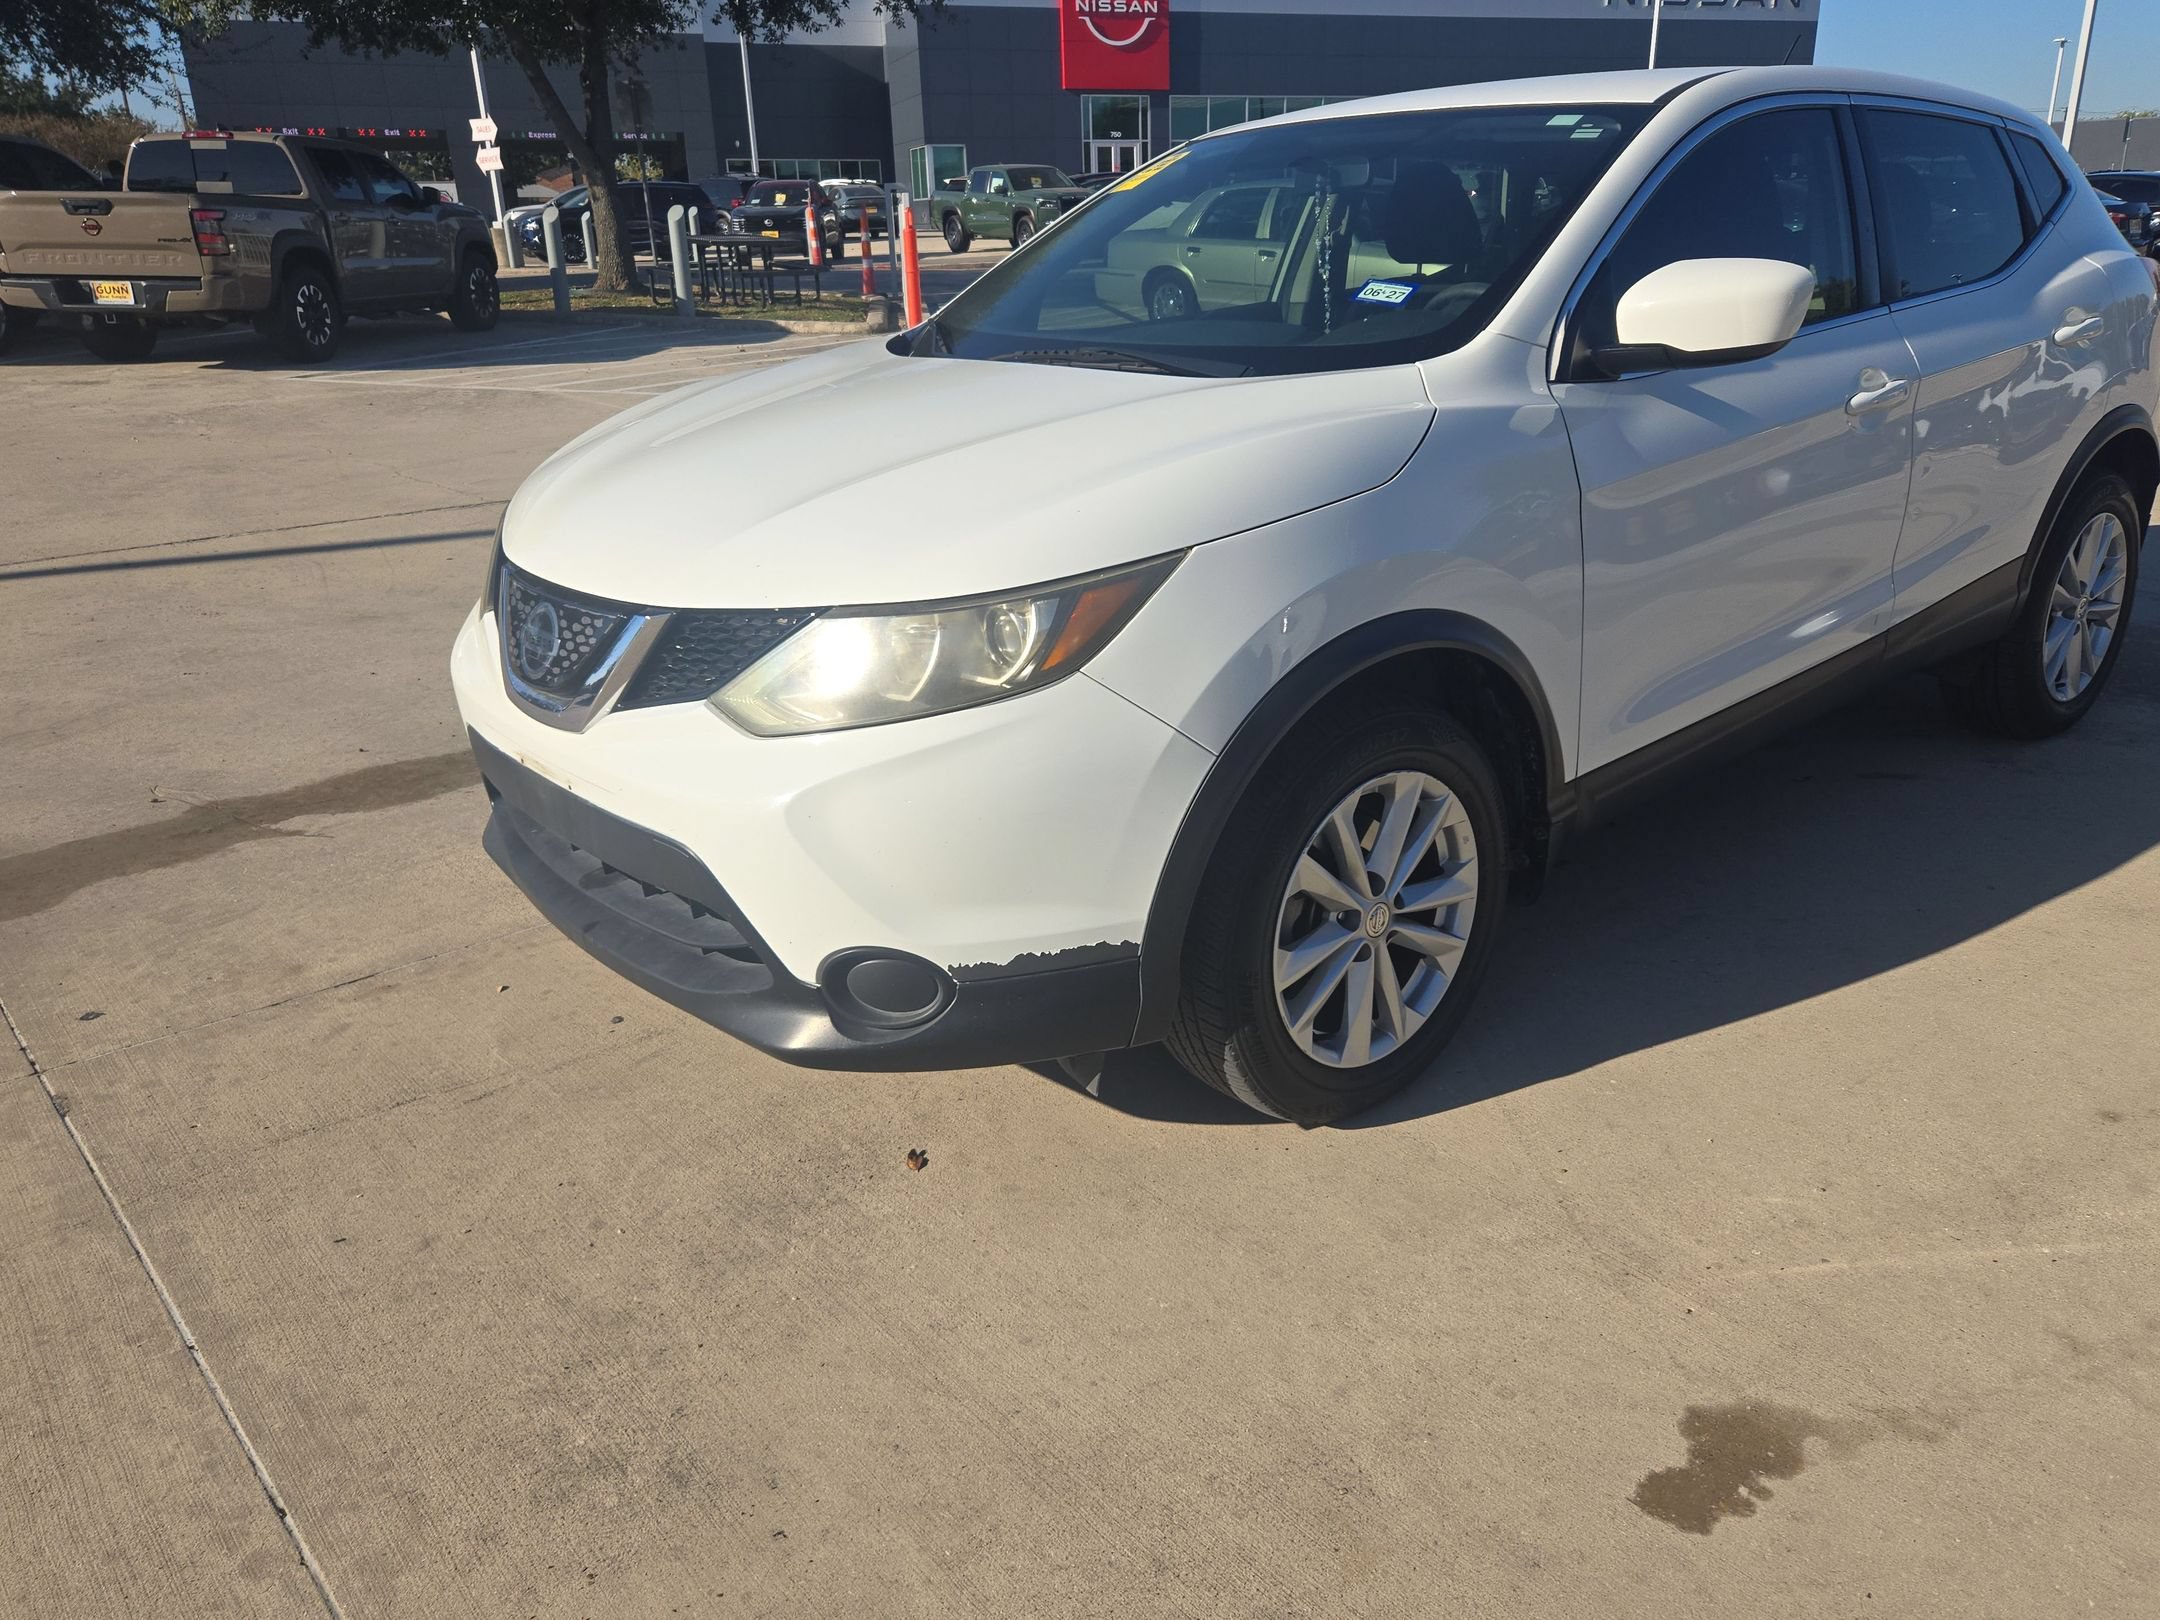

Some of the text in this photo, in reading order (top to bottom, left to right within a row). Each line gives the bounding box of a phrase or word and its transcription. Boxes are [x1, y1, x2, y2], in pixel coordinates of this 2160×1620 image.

[1075, 0, 1158, 13] NISSAN
[282, 127, 299, 135] Exit
[384, 128, 400, 136] Exit
[528, 131, 557, 139] Express
[22, 252, 185, 267] FRONTIER
[96, 285, 129, 295] GUNN
